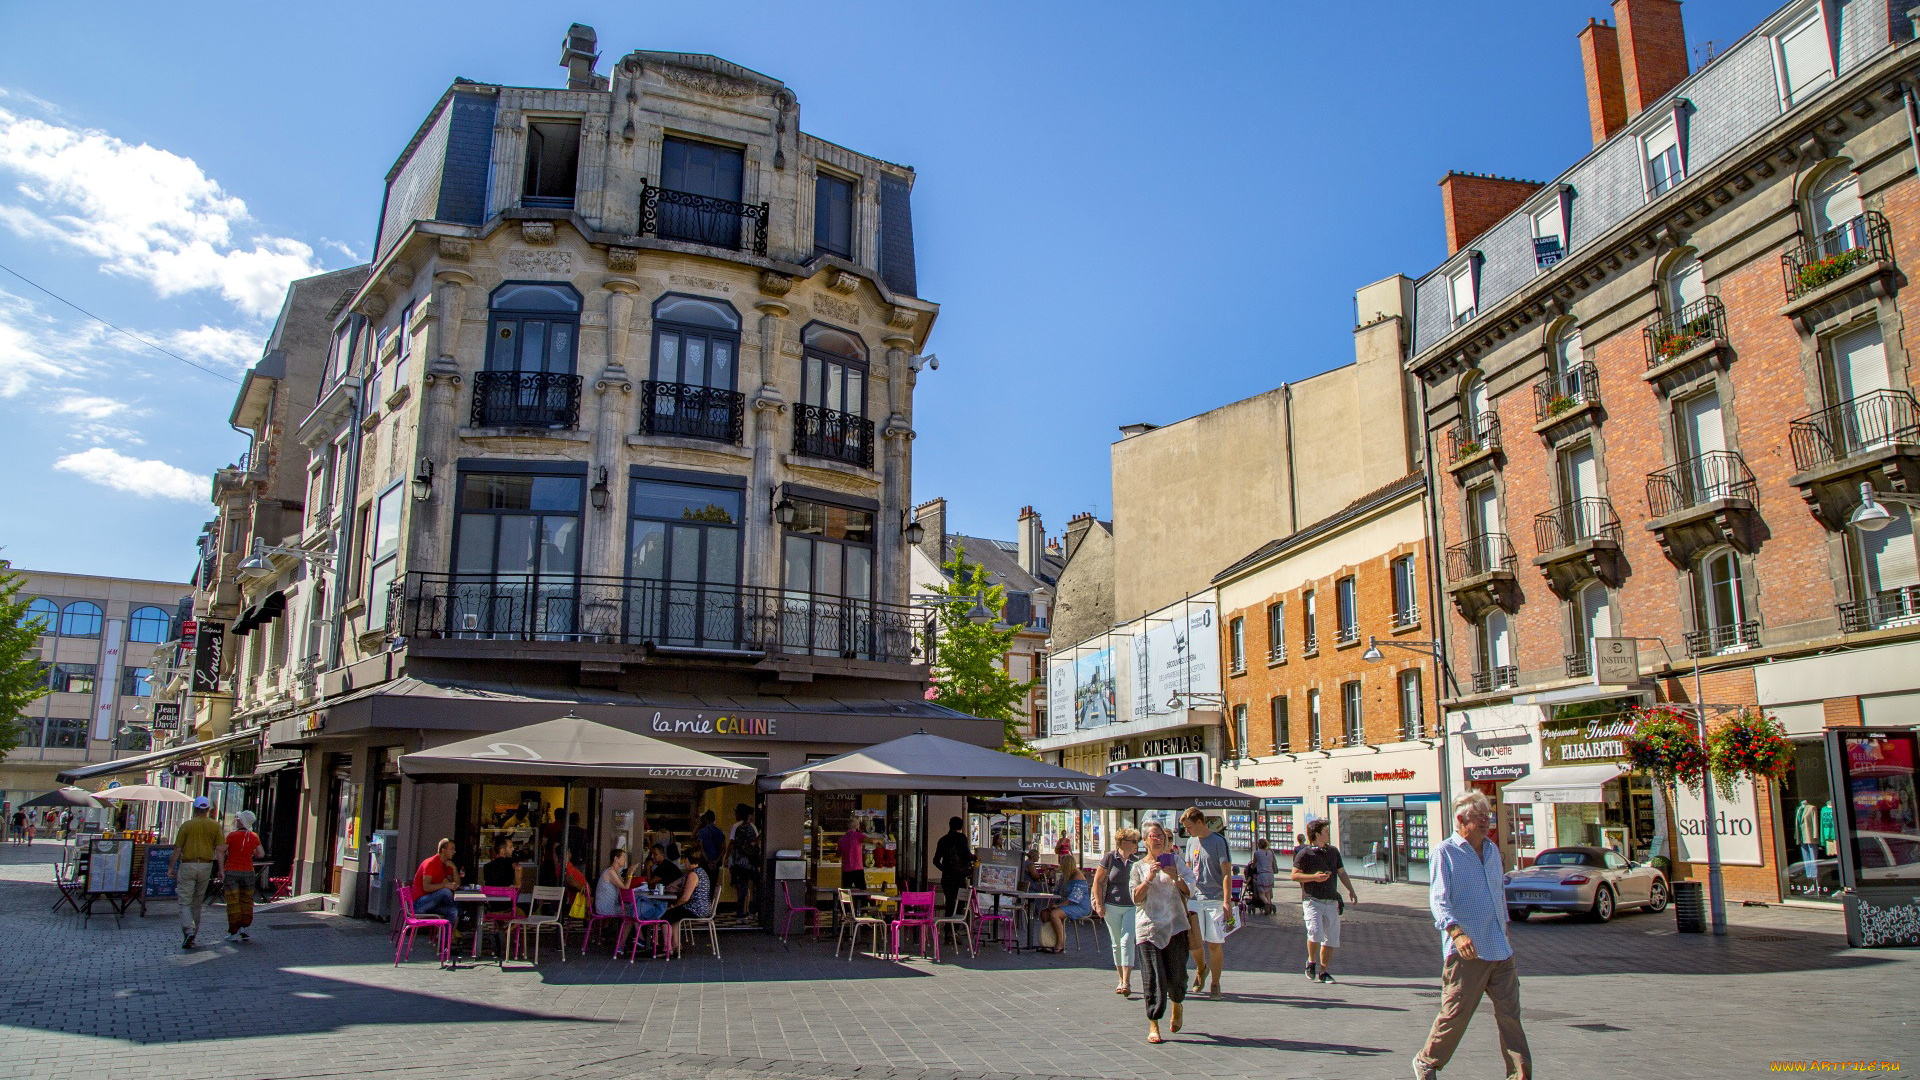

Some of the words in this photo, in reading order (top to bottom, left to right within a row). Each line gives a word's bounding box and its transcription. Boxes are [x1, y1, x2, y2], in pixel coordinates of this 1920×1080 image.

[196, 636, 222, 690] Louise
[158, 705, 176, 713] Jean
[155, 720, 177, 728] David
[653, 712, 672, 732] la
[674, 714, 712, 734] mie
[716, 714, 777, 735] CÂLINE
[1541, 727, 1579, 739] Parfumerie
[1142, 735, 1200, 757] CINEMAS
[1561, 740, 1626, 760] ELISABETH
[649, 767, 663, 776] la
[665, 768, 693, 777] mie
[1374, 768, 1416, 781] immobilier
[1018, 779, 1032, 788] la
[1032, 780, 1057, 789] mie
